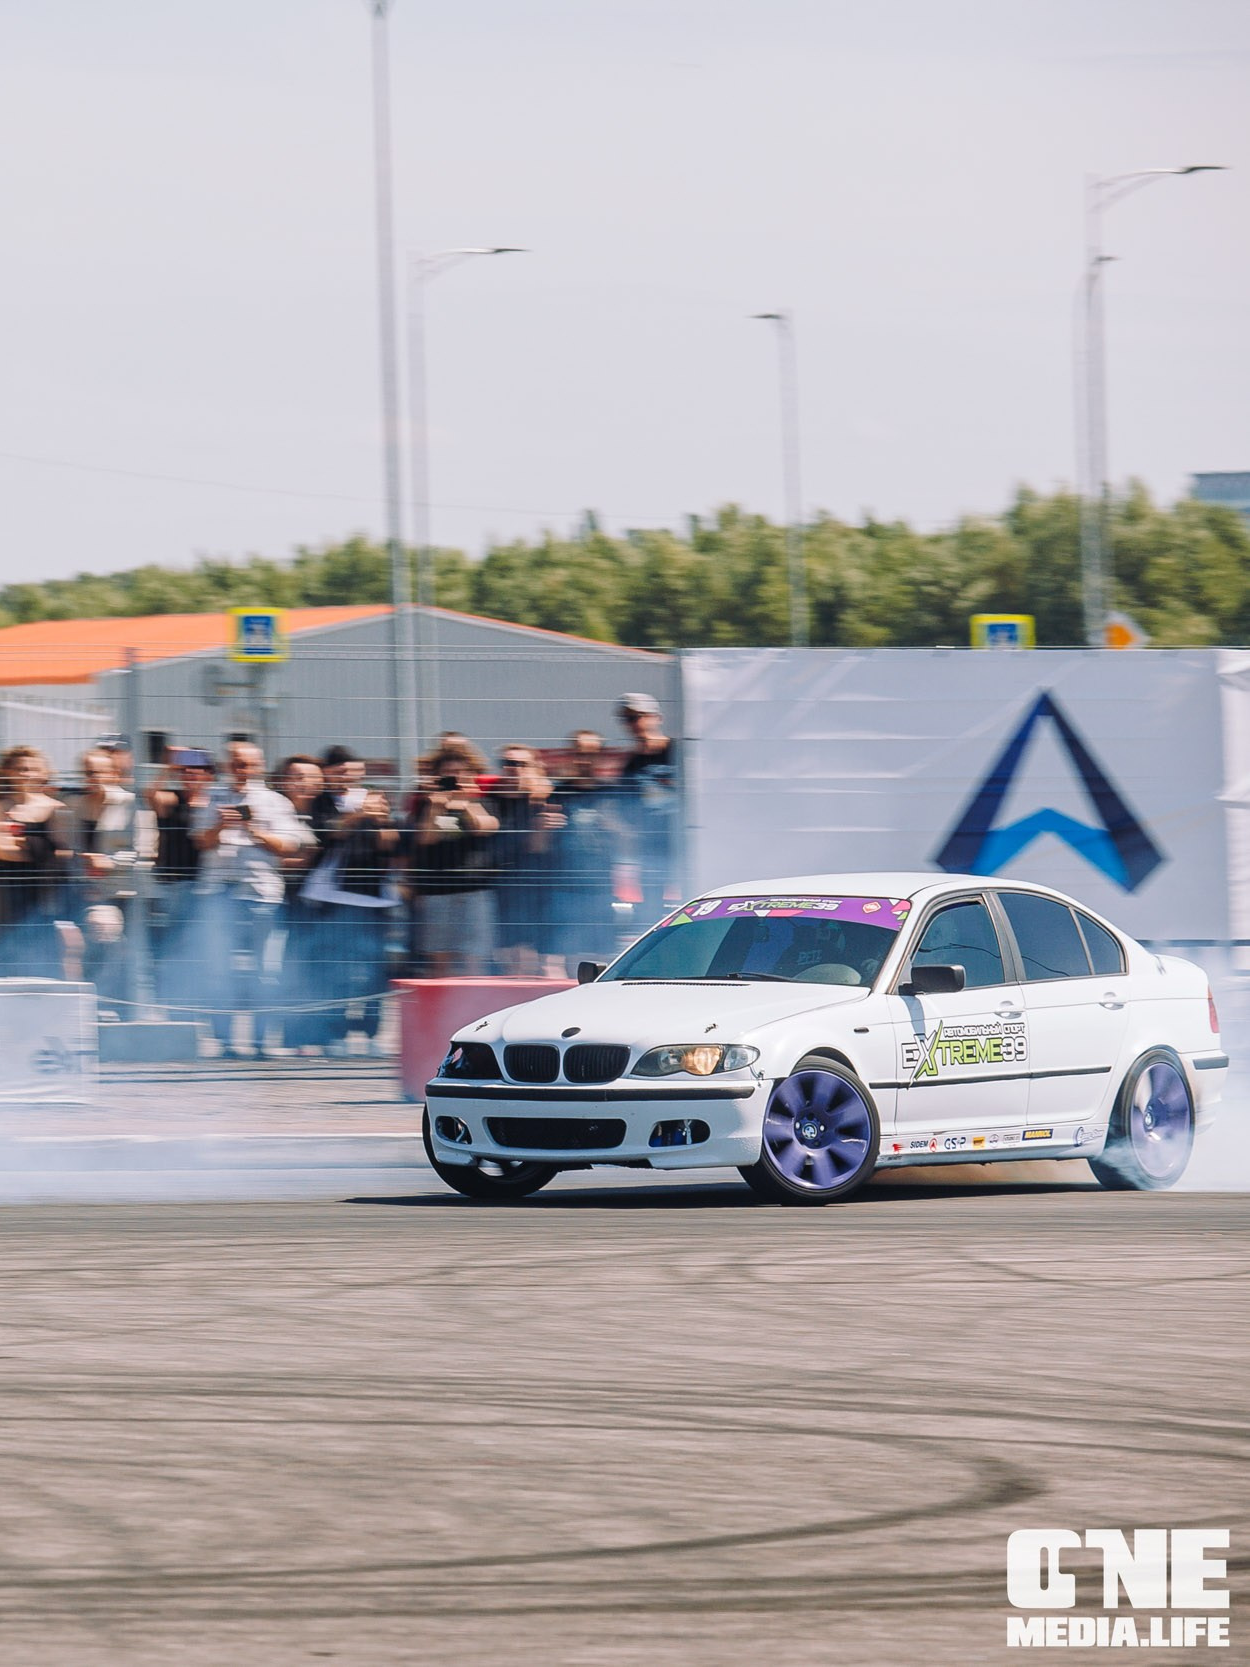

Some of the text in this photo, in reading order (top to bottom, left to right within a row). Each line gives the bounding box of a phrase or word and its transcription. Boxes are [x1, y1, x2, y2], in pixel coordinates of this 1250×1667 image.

[692, 900, 723, 917] 19
[726, 900, 840, 914] EXTREME39
[943, 1021, 1026, 1038] АВТОМОБИЛЬНЫЙ СПОРТ
[901, 1019, 1027, 1086] EXTREME39
[910, 1140, 929, 1149] SIDEM
